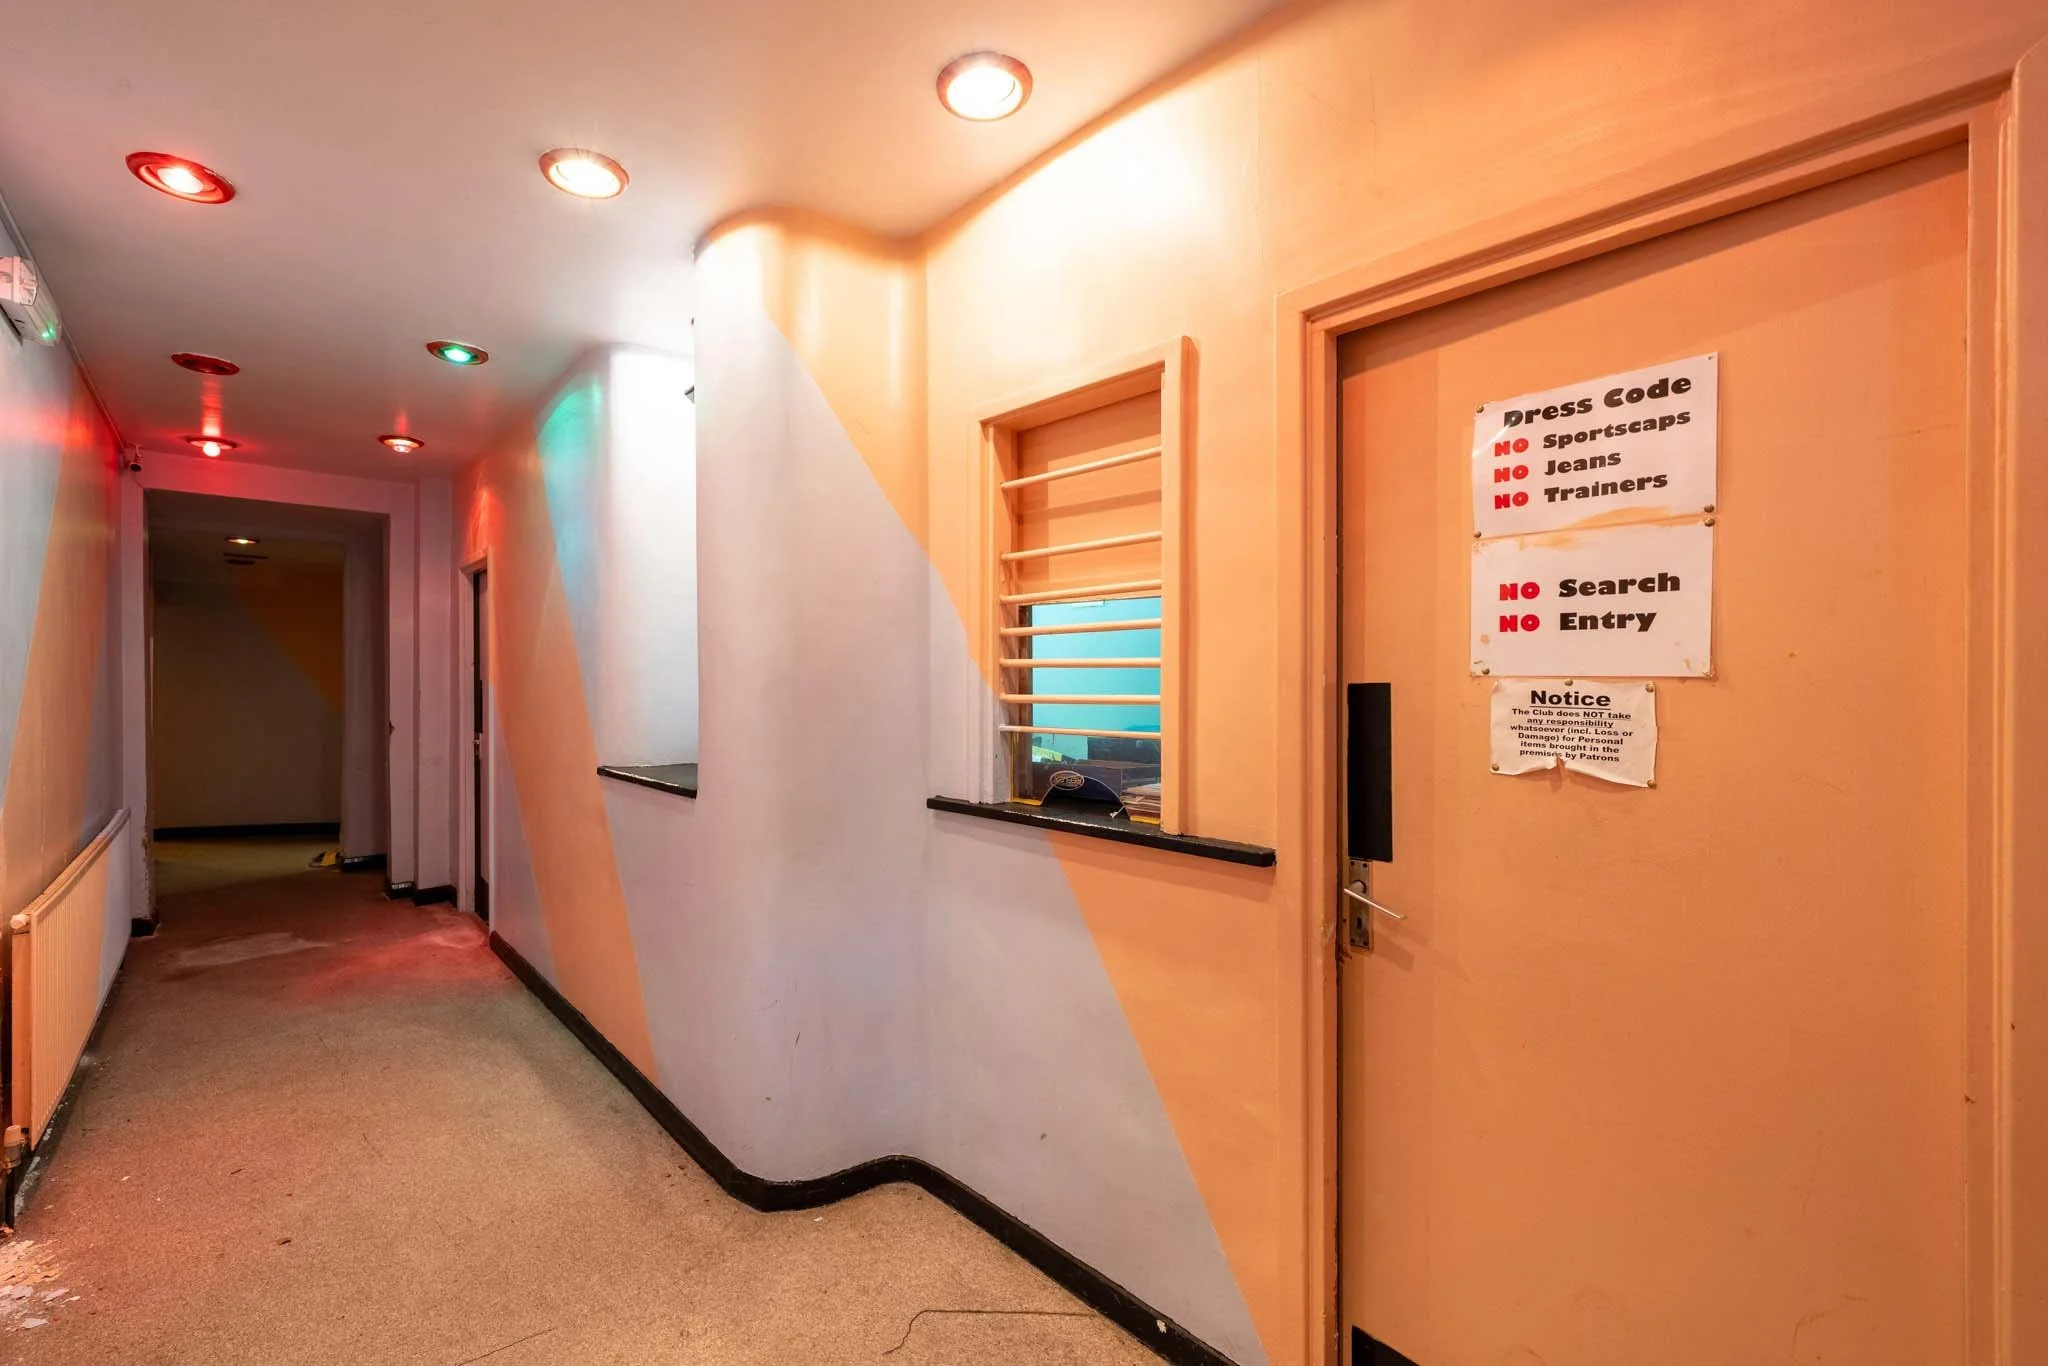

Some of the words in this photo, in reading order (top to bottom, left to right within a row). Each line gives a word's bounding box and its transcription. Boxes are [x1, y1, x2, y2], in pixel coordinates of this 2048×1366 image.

[1504, 398, 1593, 428] Dress
[1603, 377, 1692, 408] Code
[1494, 438, 1529, 457] NO
[1543, 411, 1691, 450] Sportscaps
[1494, 464, 1529, 483] NO
[1544, 452, 1622, 476] Jeans
[1494, 491, 1529, 510] NO
[1544, 474, 1668, 503] Trainers
[1499, 582, 1541, 601] NO
[1558, 572, 1681, 598] Search
[1499, 614, 1541, 633] NO
[1559, 610, 1657, 632] Entry
[1530, 690, 1612, 706] Notice
[1510, 725, 1564, 733] whatsoever
[1567, 727, 1591, 735] (incl.
[1595, 728, 1619, 736] Loss
[1546, 719, 1613, 728] responsibility
[1518, 732, 1559, 742] Damage)
[1578, 736, 1623, 745] Personal
[1549, 743, 1586, 751] brought
[1565, 752, 1576, 760] by
[1579, 753, 1620, 762] Patrons
